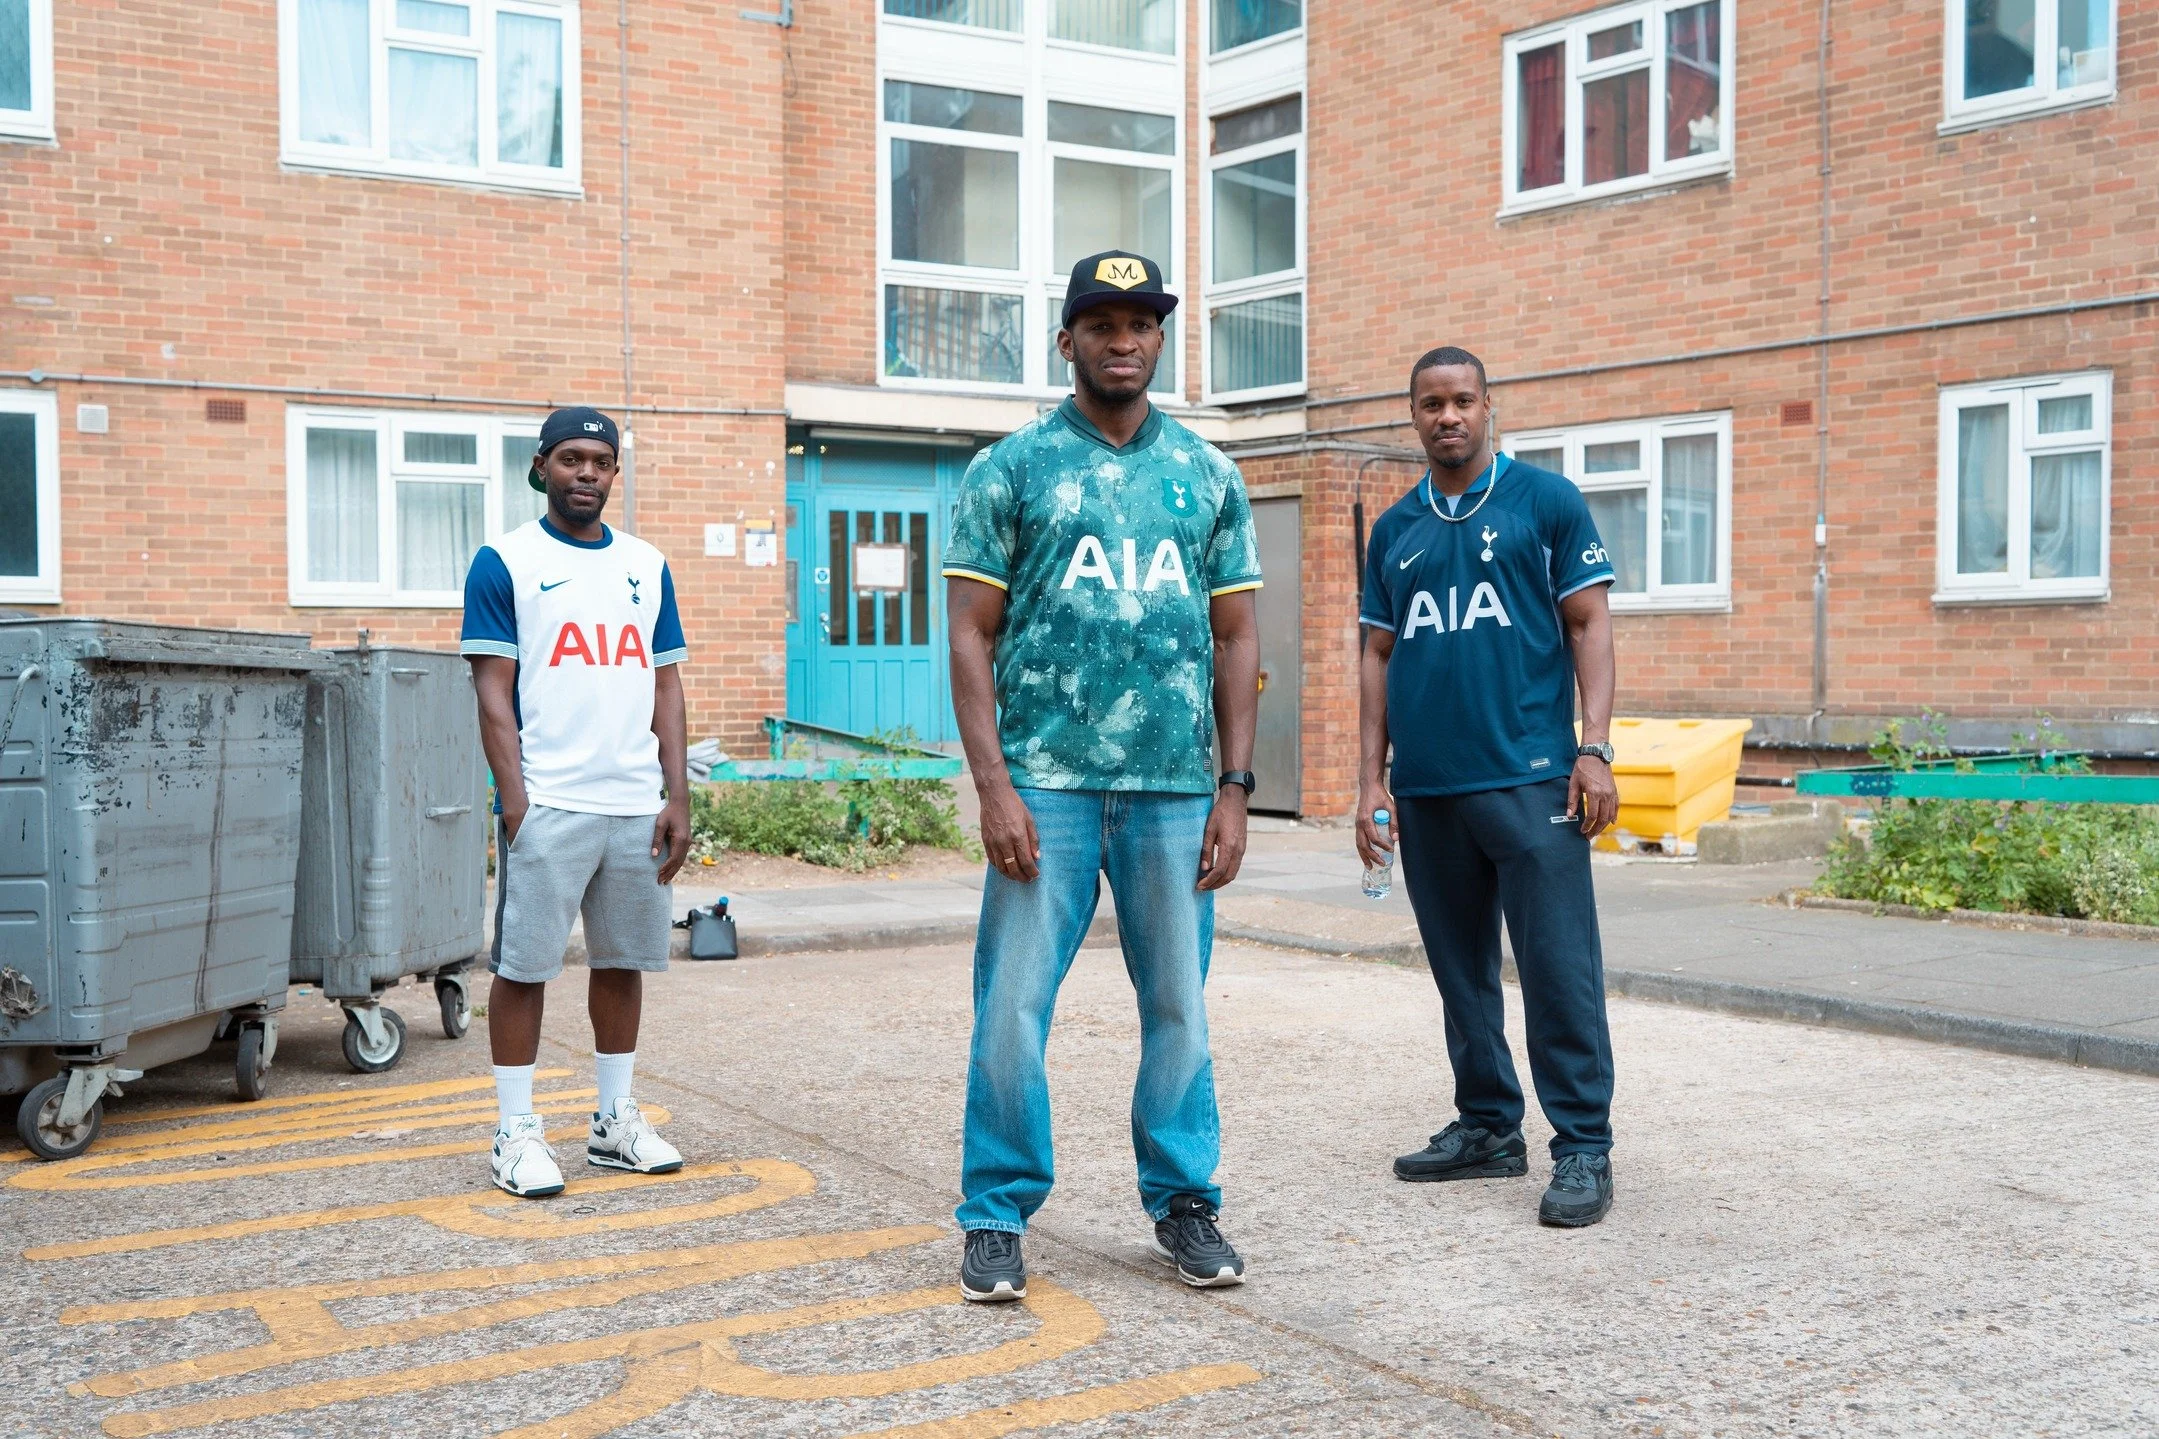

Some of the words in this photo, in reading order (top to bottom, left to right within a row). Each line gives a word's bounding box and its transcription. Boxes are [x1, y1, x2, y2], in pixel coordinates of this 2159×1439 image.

[1107, 263, 1138, 280] M
[1060, 535, 1190, 596] AIA
[1403, 581, 1512, 639] AIA
[549, 622, 648, 668] AIA
